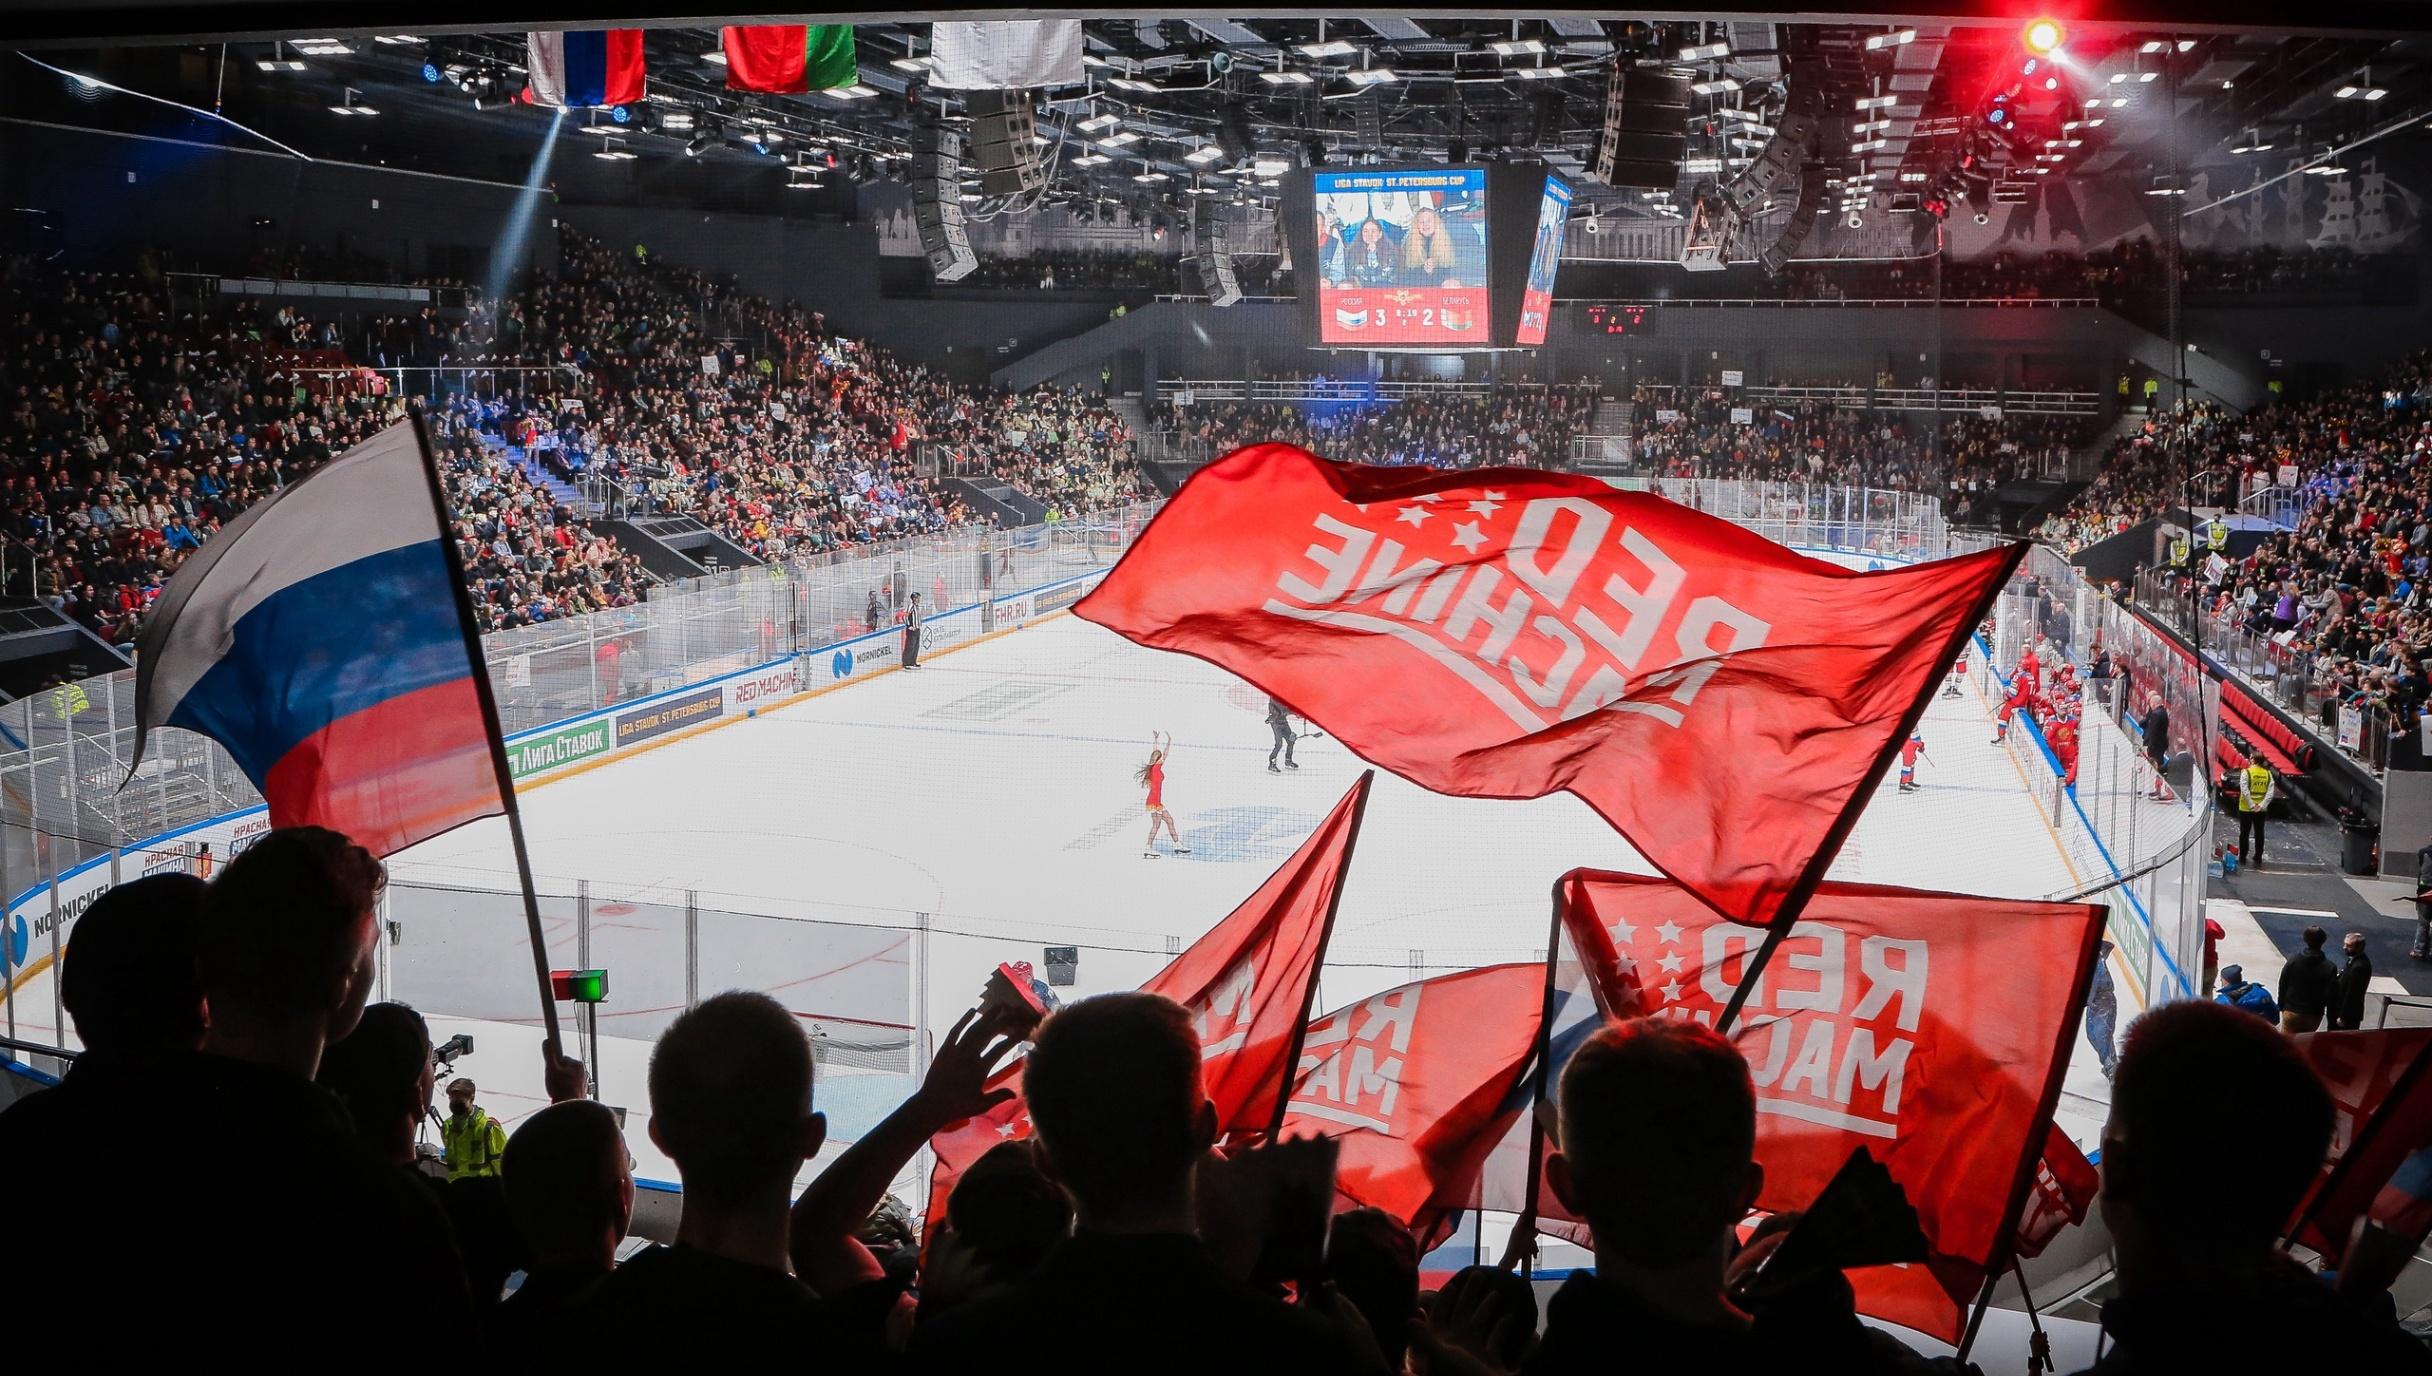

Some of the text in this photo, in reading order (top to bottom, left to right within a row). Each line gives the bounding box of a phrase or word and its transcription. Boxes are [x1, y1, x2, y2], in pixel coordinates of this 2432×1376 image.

[1449, 176, 1465, 185] CUP
[1375, 309, 1386, 326] 3
[1423, 308, 1434, 326] 2
[994, 600, 1028, 625] FHR.RU
[857, 645, 893, 664] NORNICKEL
[736, 671, 796, 704] RED MACHIN
[618, 722, 634, 737] LIGA
[709, 696, 721, 709] CUP
